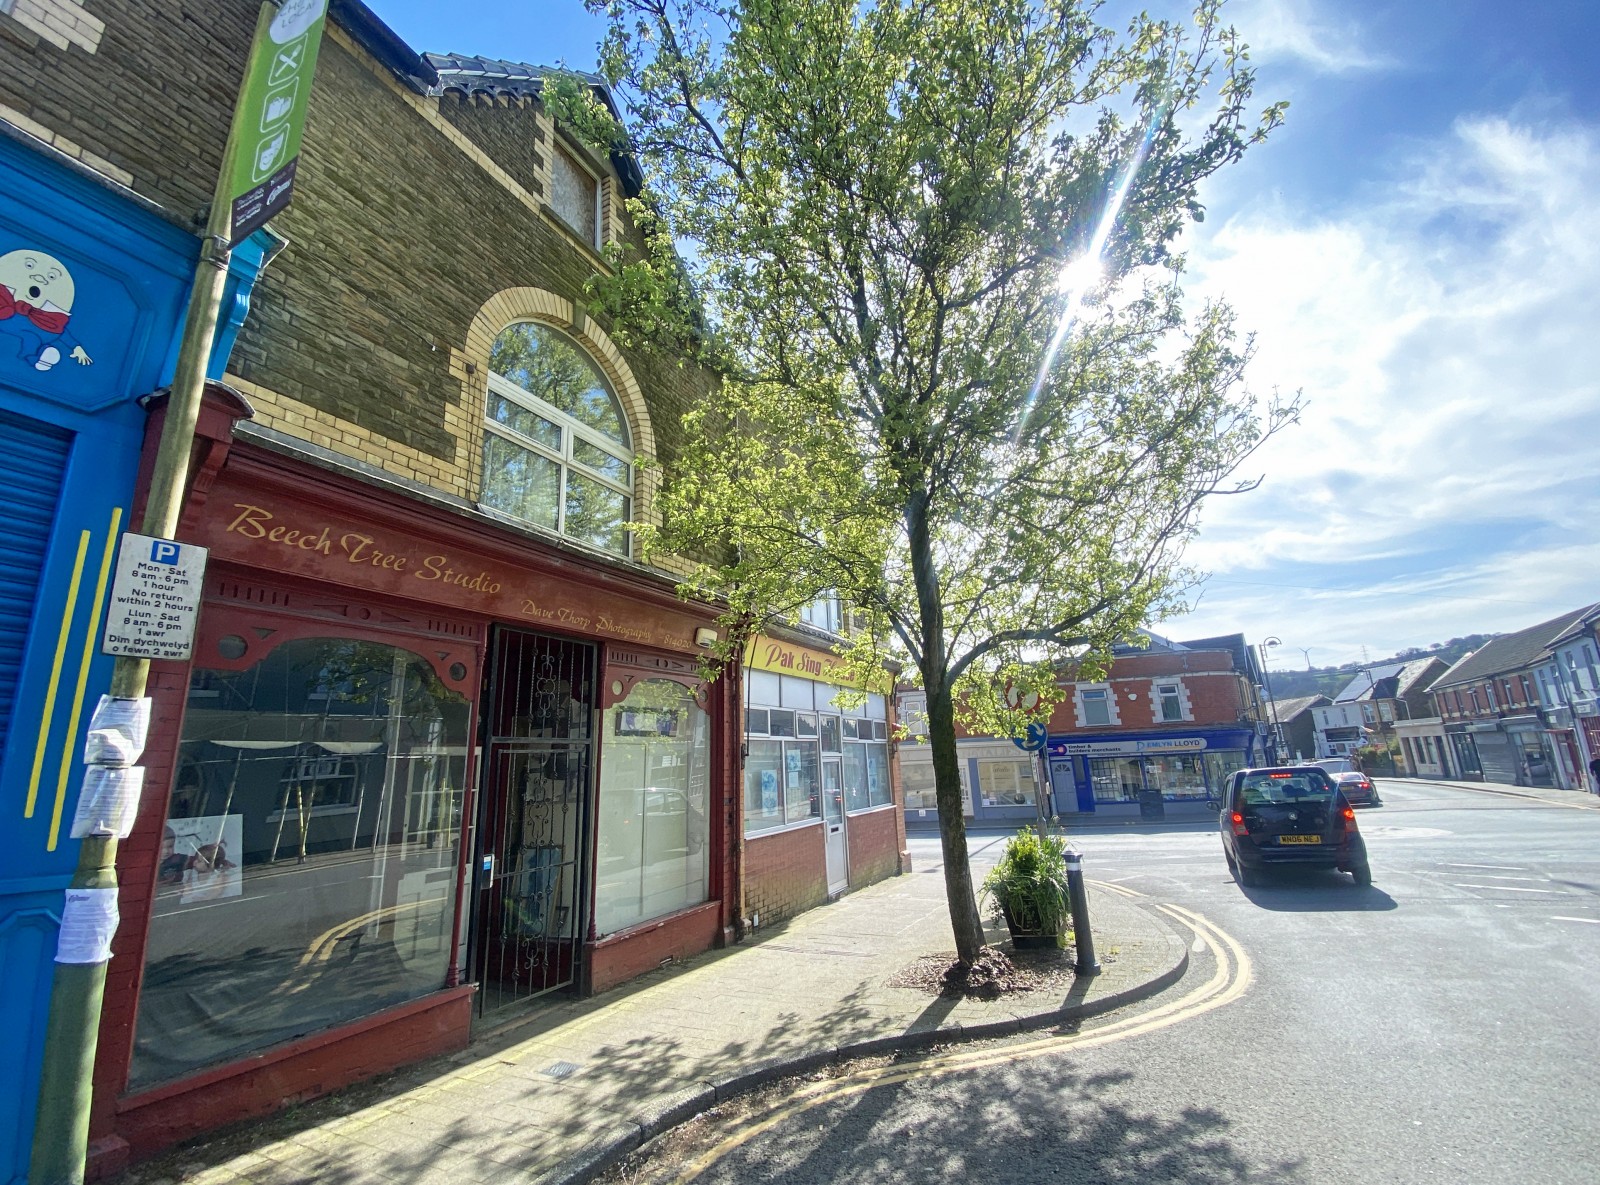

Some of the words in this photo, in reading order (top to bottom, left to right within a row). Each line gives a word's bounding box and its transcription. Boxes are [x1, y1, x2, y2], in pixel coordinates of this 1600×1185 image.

[155, 543, 176, 561] P
[226, 503, 330, 555] Beech
[341, 533, 405, 571] Tree
[415, 555, 501, 594] Studio
[137, 562, 160, 572] Mon
[168, 568, 187, 577] Sat
[140, 572, 157, 580] am
[173, 577, 189, 586] pm
[151, 582, 175, 591] hour
[131, 588, 147, 597] No
[150, 592, 183, 602] return
[117, 596, 151, 606] within
[164, 602, 193, 612] hours
[128, 609, 152, 618] Llun
[160, 613, 180, 622] Sad
[123, 617, 131, 625] 8
[157, 621, 164, 629] 6
[166, 623, 182, 633] pm
[520, 599, 554, 619] Dave
[557, 607, 591, 630] Thorp
[595, 615, 652, 642] Photography
[664, 634, 692, 649] 814020
[145, 629, 165, 637] awr
[108, 634, 130, 644] Dim
[133, 638, 190, 650] dychwelyd
[122, 645, 150, 655] fewn
[153, 648, 160, 656] 2
[765, 643, 795, 668] Pak
[796, 652, 821, 677] Sing
